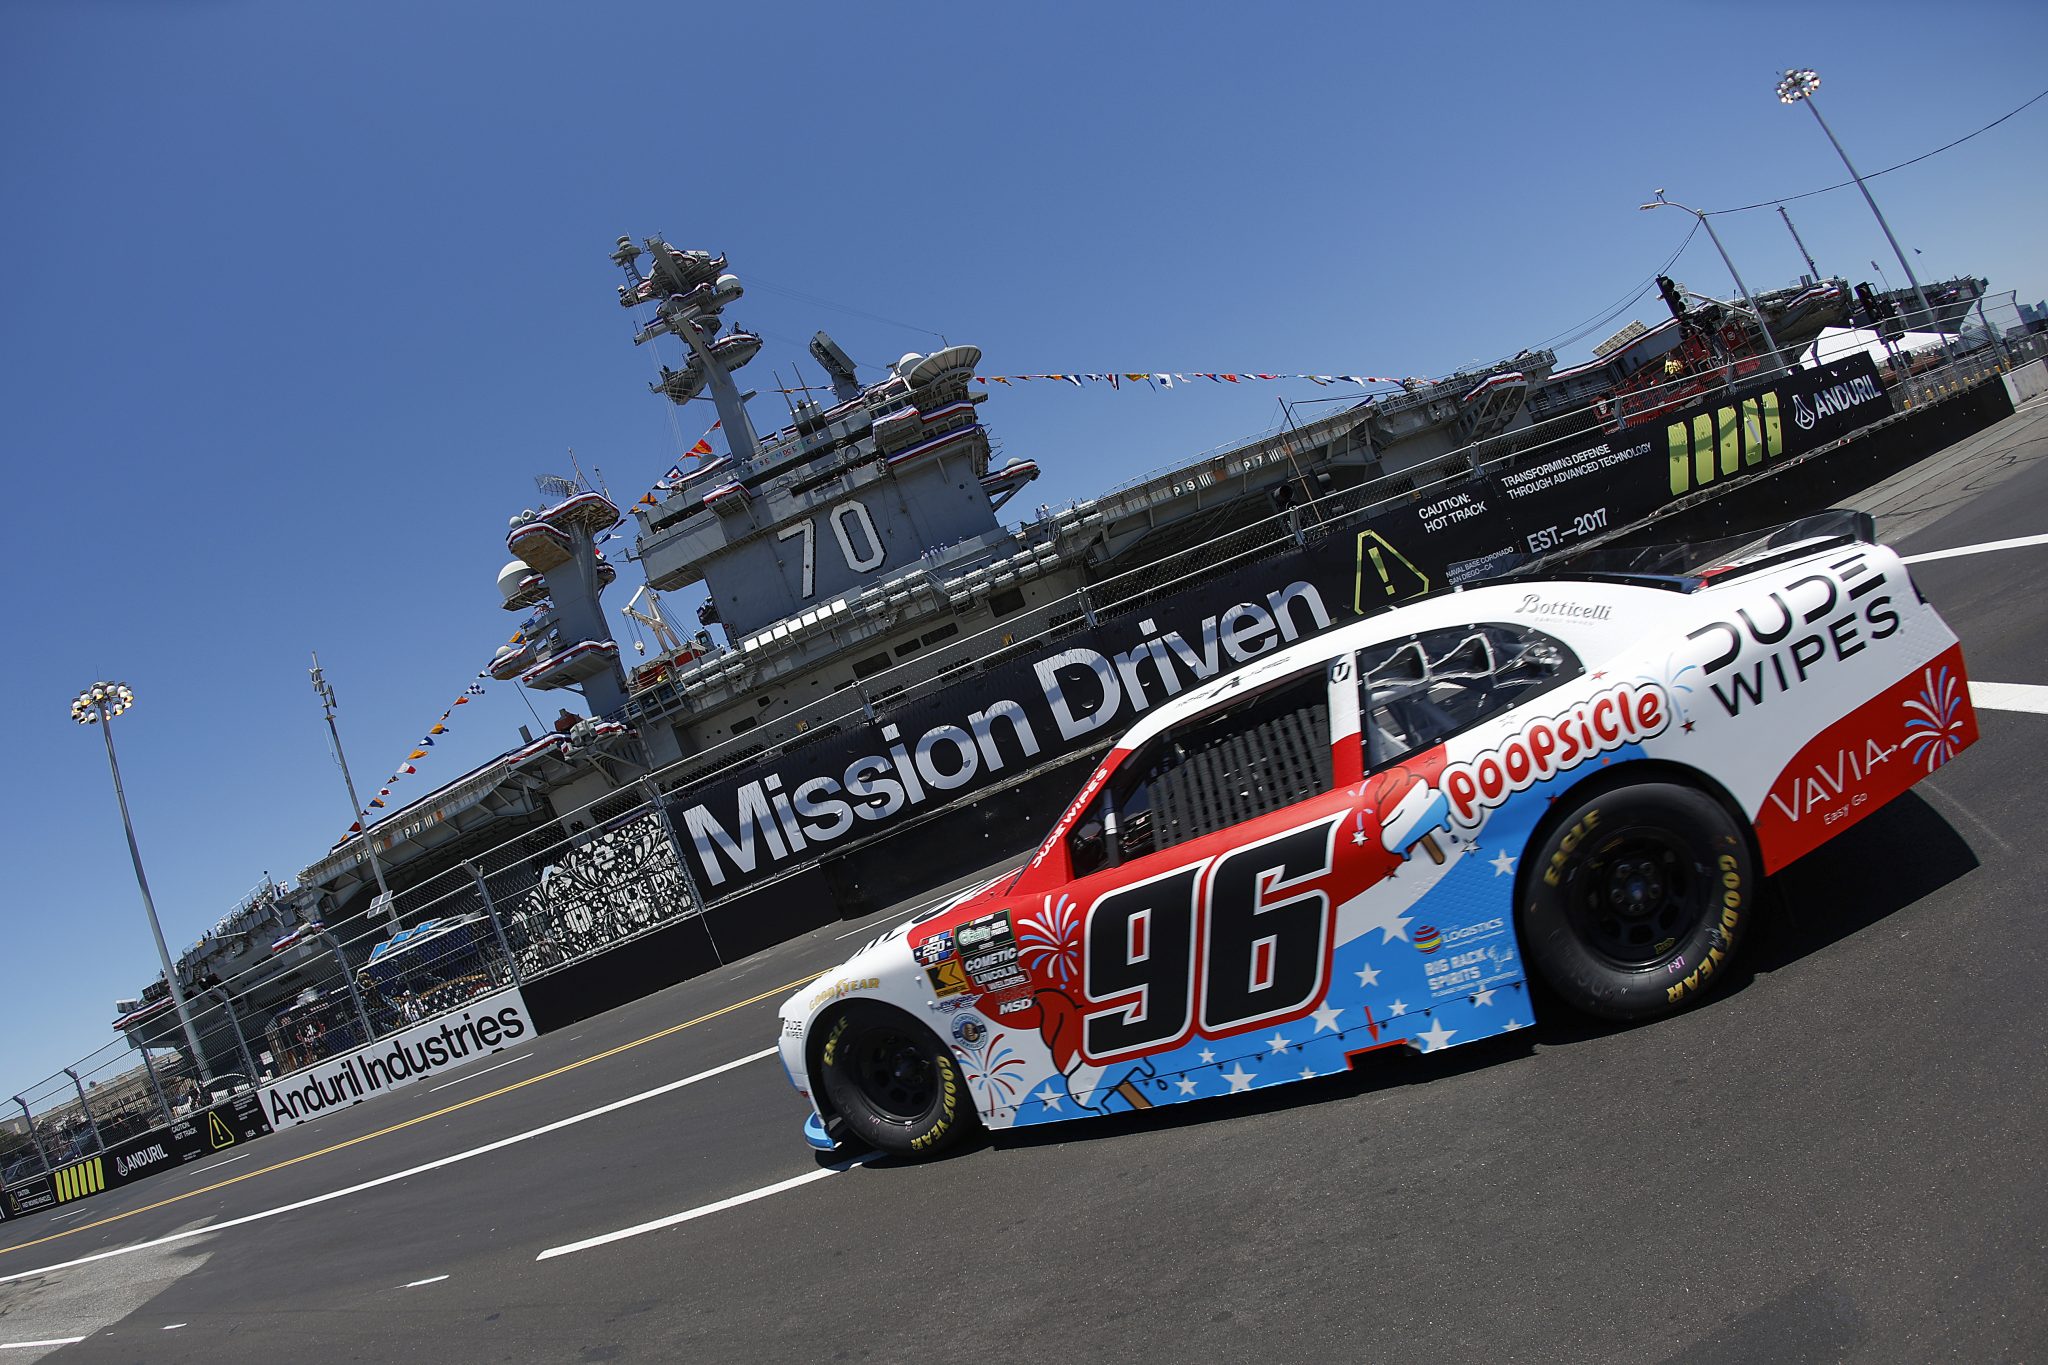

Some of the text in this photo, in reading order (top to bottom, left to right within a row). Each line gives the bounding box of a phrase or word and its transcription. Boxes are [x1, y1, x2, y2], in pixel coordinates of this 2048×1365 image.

[1815, 374, 1882, 419] ANDURIL
[1501, 443, 1611, 488] TRANSFORMING DEFENSE
[1507, 442, 1652, 500] THROUGH ADVANCED TECHNOLOGY
[1418, 493, 1471, 519] CAUTION:
[1424, 501, 1488, 533] HOT TRACK
[777, 499, 887, 600] 70
[1445, 546, 1514, 578] NAVAL BASE CORONADO
[1448, 576, 1462, 585] SAN
[1515, 594, 1613, 621] Botticelli
[1686, 553, 1887, 676] DUDE
[1710, 596, 1900, 718] WIPES
[682, 580, 1331, 886] Mission Driven
[1770, 739, 1890, 822] VAVIA
[1032, 768, 1108, 869] DUDE WIPES
[1824, 793, 1868, 825] Easy Go
[1082, 807, 1355, 1061] 96
[1443, 917, 1504, 943] LOGISTICS
[922, 940, 946, 957] 250
[965, 947, 1017, 972] COMETIC
[974, 965, 1018, 984] LINCOLN
[1424, 958, 1450, 976] BIG
[1000, 996, 1033, 1015] MSD
[269, 1007, 525, 1126] Anduril Industries
[175, 1131, 184, 1140] HOT
[245, 1129, 257, 1138] USA
[127, 1143, 168, 1171] ANDURIL
